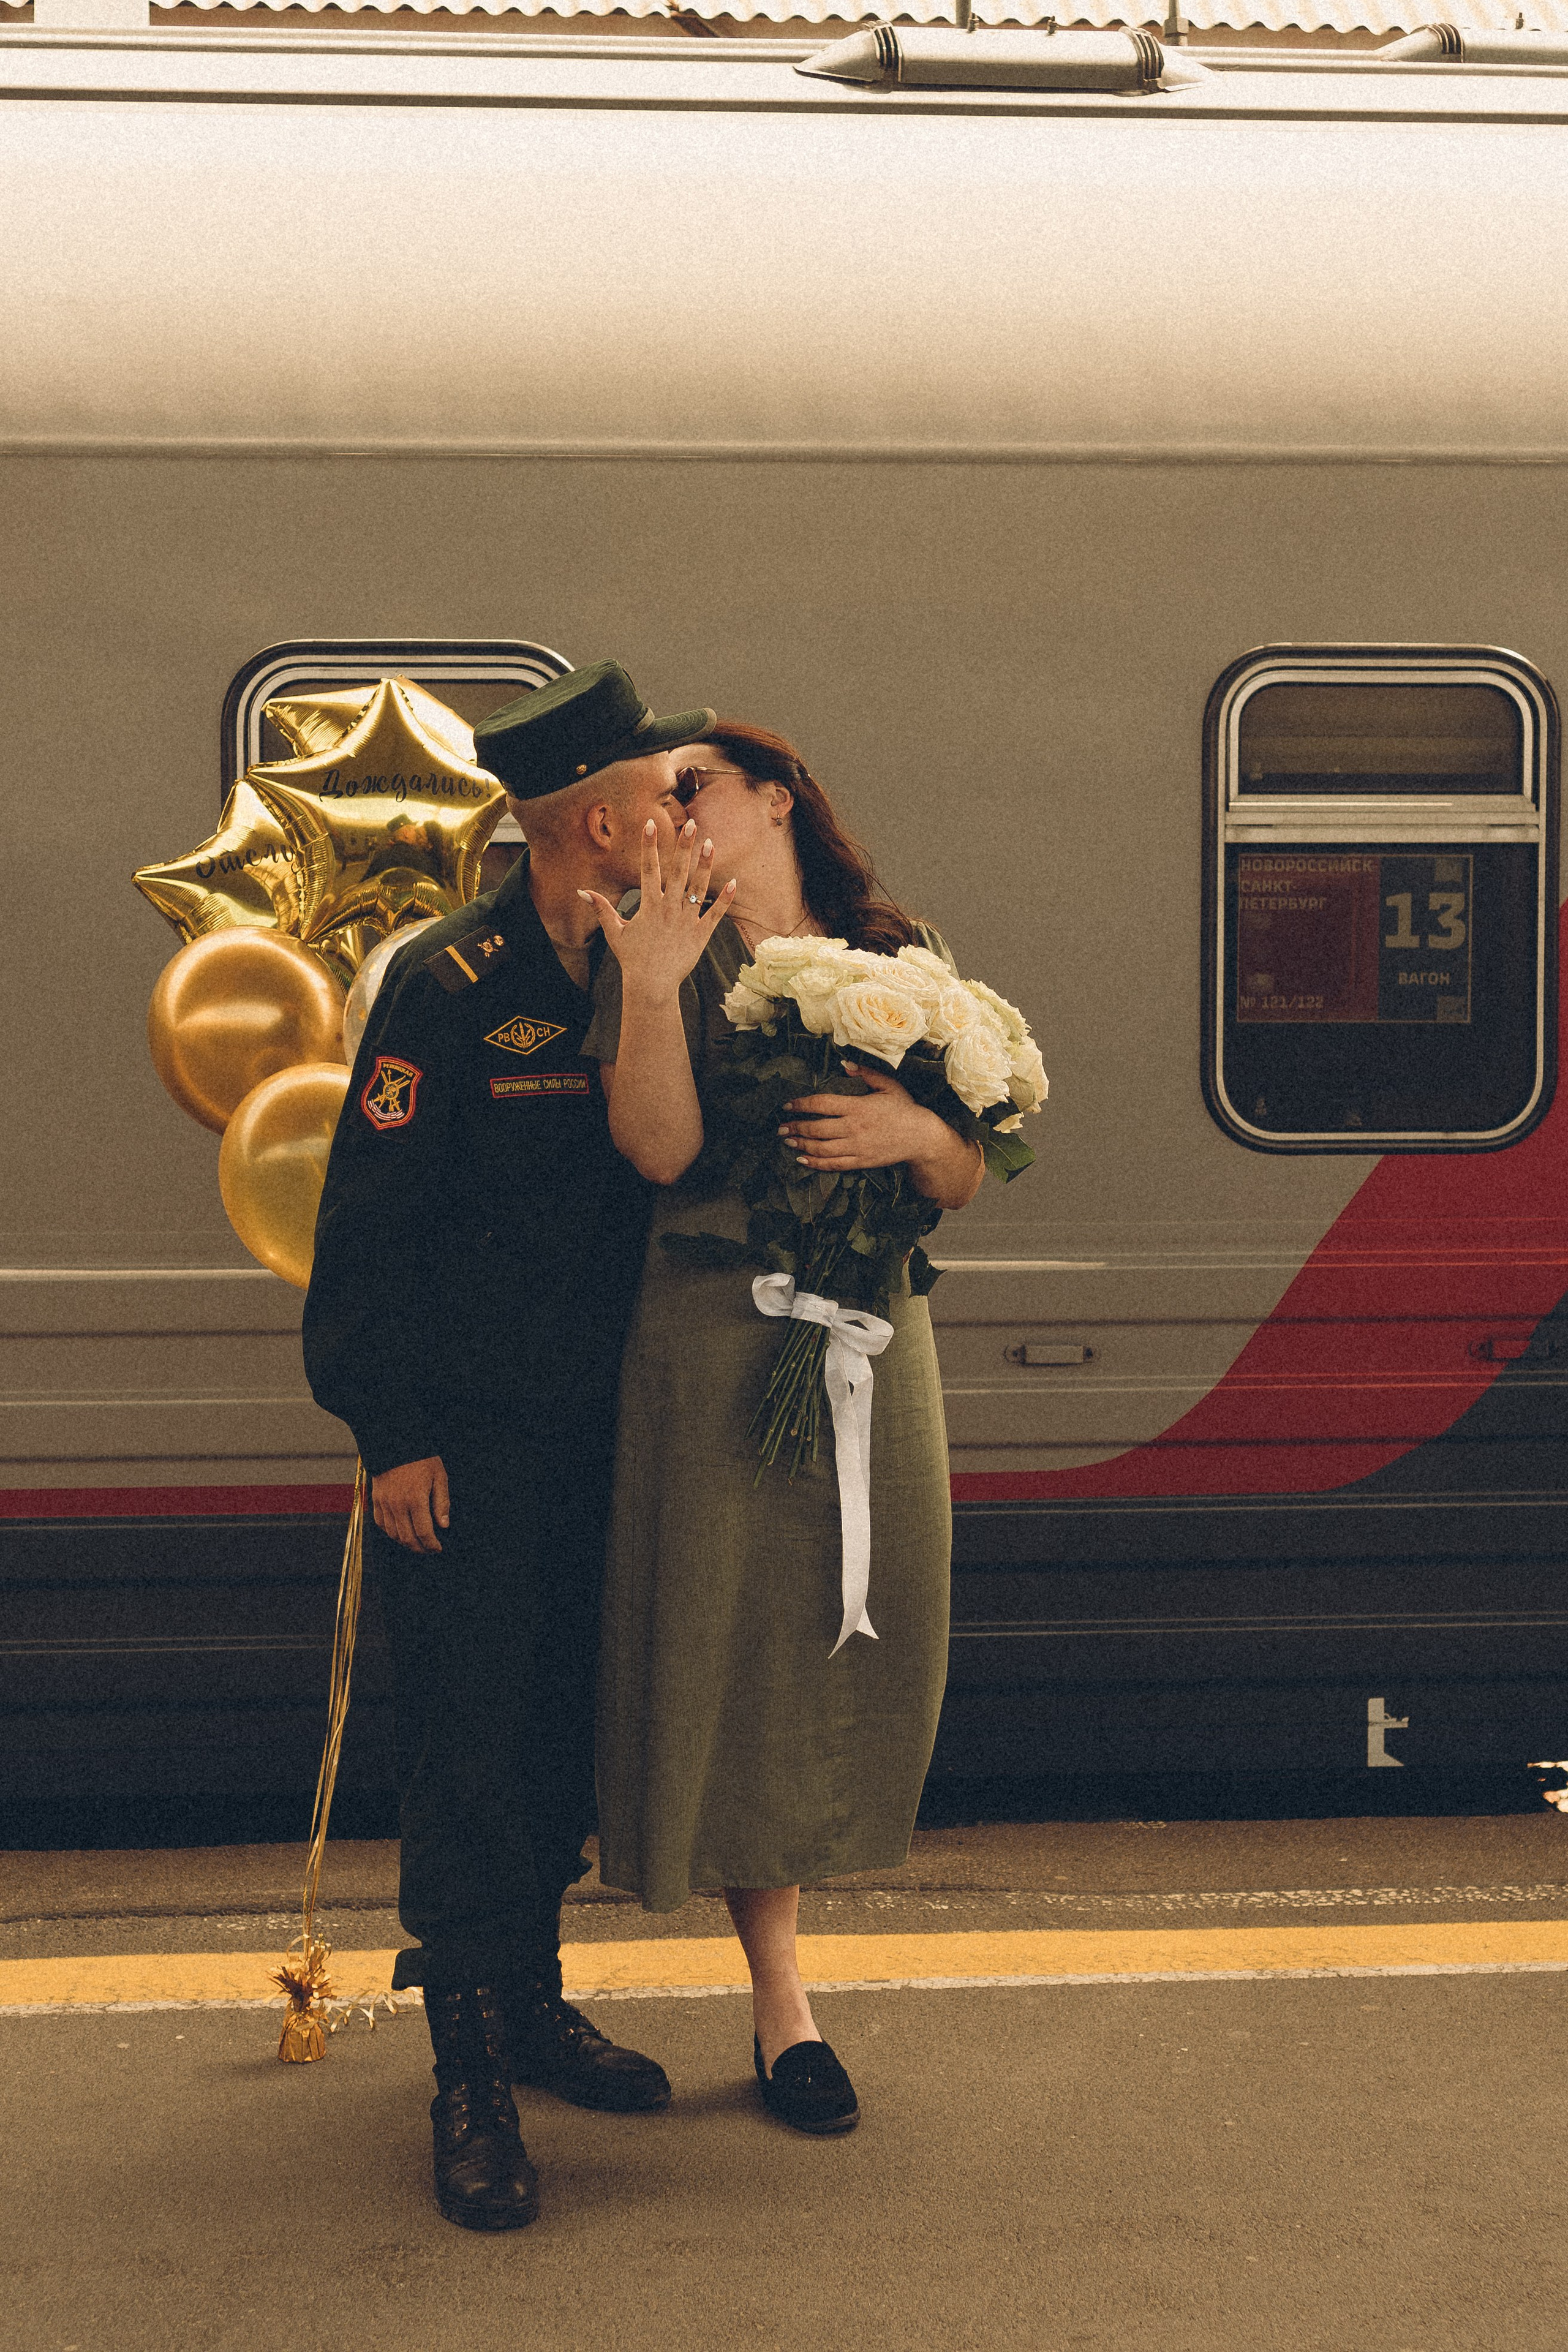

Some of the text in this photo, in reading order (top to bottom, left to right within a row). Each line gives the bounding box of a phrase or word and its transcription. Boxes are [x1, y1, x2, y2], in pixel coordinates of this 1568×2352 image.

[318, 769, 491, 802] Дождались!
[1238, 897, 1327, 910] ПЕТЕРБУРГ
[1384, 892, 1466, 950] 13
[1398, 971, 1450, 986] ВАГОН
[494, 1077, 586, 1093] ВООРУЖЕННЫЕ СИЛЫ РОССИИ
